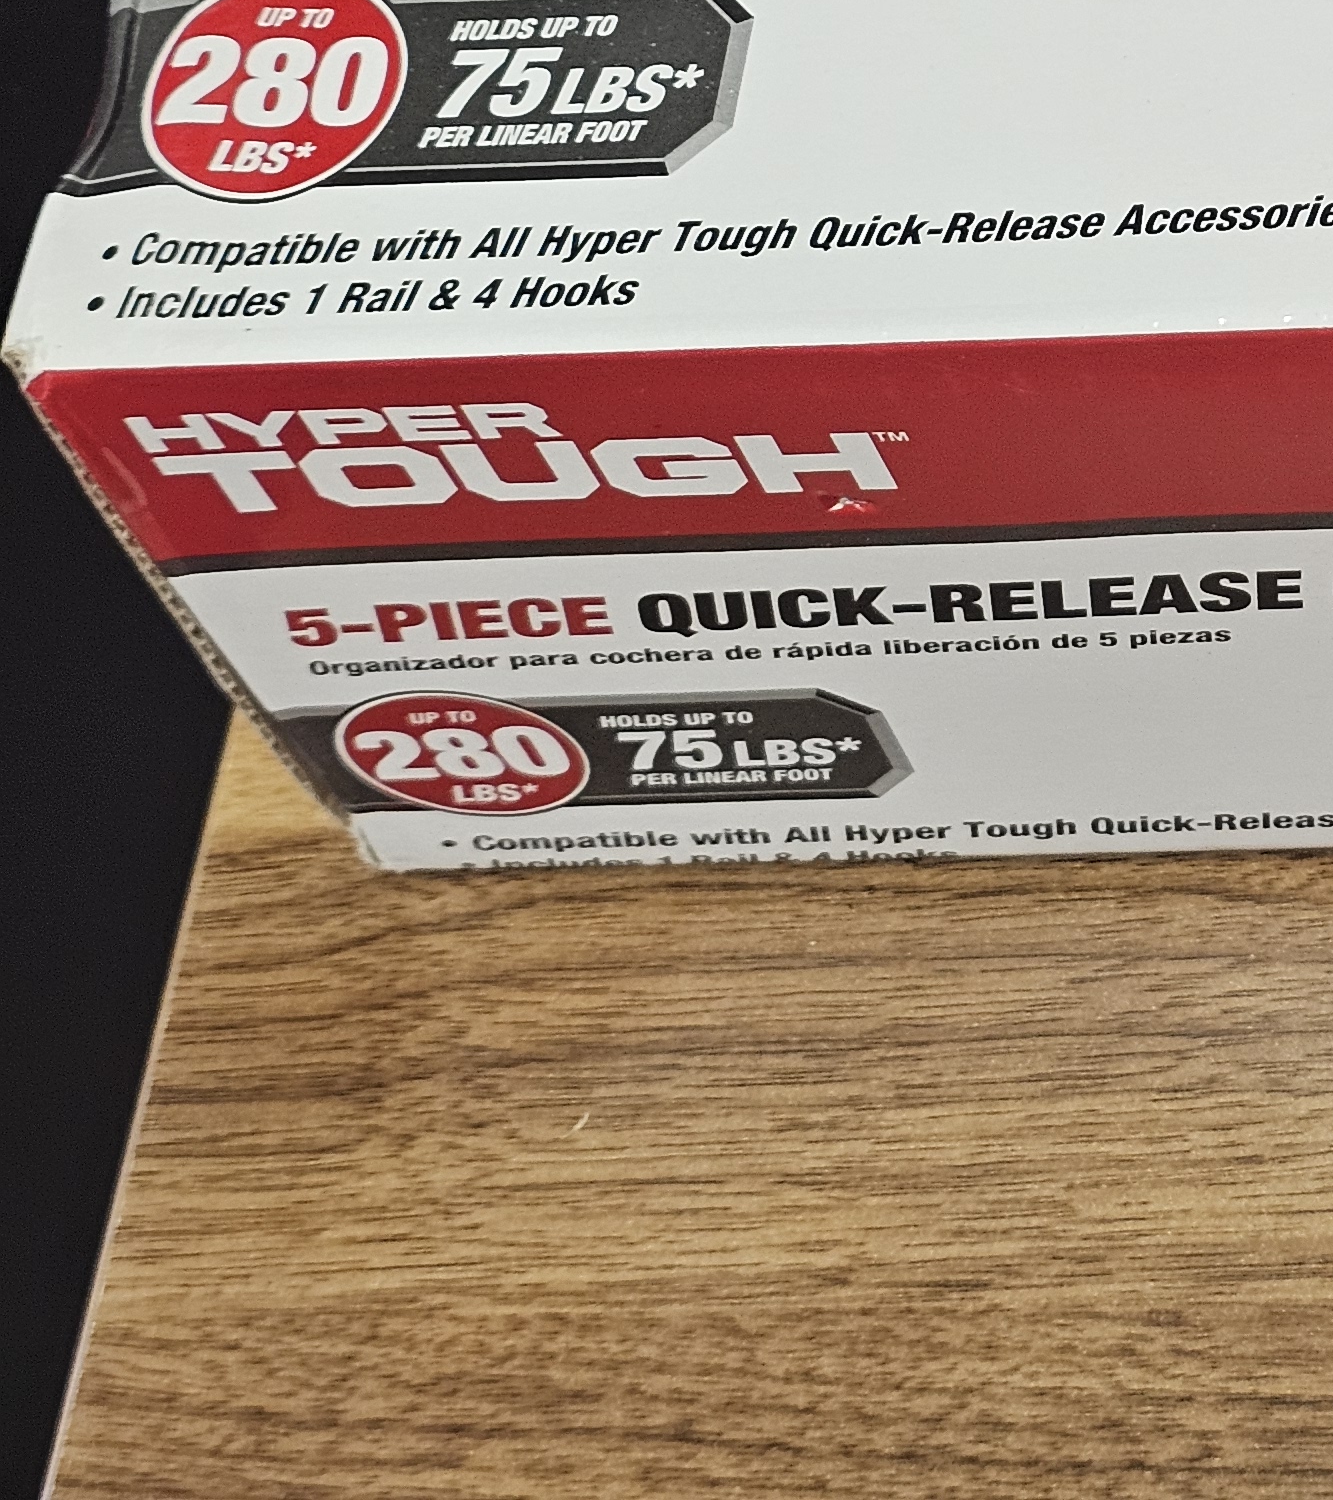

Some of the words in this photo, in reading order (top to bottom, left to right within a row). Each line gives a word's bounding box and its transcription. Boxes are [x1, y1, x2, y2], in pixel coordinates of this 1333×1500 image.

[256, 7, 297, 27] UP
[300, 8, 334, 28] TO
[450, 18, 538, 41] HOLDS
[540, 17, 579, 38] UP
[584, 15, 618, 36] TO
[155, 35, 388, 127] 280
[436, 47, 563, 118] 75
[418, 126, 474, 148] PER
[475, 123, 573, 146] LINEAR
[574, 120, 648, 143] FOOT
[132, 232, 359, 273] Compatible
[372, 229, 461, 261] with
[468, 227, 532, 258] All
[537, 225, 662, 263] Hyper
[674, 219, 797, 257] Tough
[810, 210, 1105, 251] Quick-Release
[116, 286, 290, 318] Includes
[306, 284, 327, 314] 1
[337, 280, 423, 313] Rail
[428, 279, 460, 310] &
[473, 279, 502, 308] 4
[510, 275, 639, 308] Hooks
[123, 403, 563, 453] HYPER
[152, 432, 898, 513] TOUGH
[285, 597, 614, 646] 5-PIECE
[638, 570, 1303, 637] QUICK-RELEASE
[310, 655, 497, 676] Organizador
[510, 654, 579, 670] para
[590, 648, 713, 664] cochera
[725, 645, 761, 660] de
[773, 642, 872, 660] rápida
[884, 635, 1039, 654] liberación
[1052, 634, 1087, 648] de
[1100, 632, 1117, 646] 5
[1130, 630, 1231, 649] piezas
[409, 712, 439, 724] UP
[446, 711, 476, 723] TO
[599, 714, 678, 728] HOLDS
[684, 713, 715, 725] UP
[722, 711, 753, 724] TO
[354, 726, 570, 782] 280
[617, 730, 723, 770] 75
[630, 773, 677, 786] PER
[684, 770, 767, 784] LINEAR
[774, 768, 832, 781] FOOT
[472, 831, 678, 852] Compatible
[691, 829, 771, 845] with
[784, 826, 831, 843] All
[845, 825, 951, 844] Hyper
[963, 819, 1076, 839] Tough
